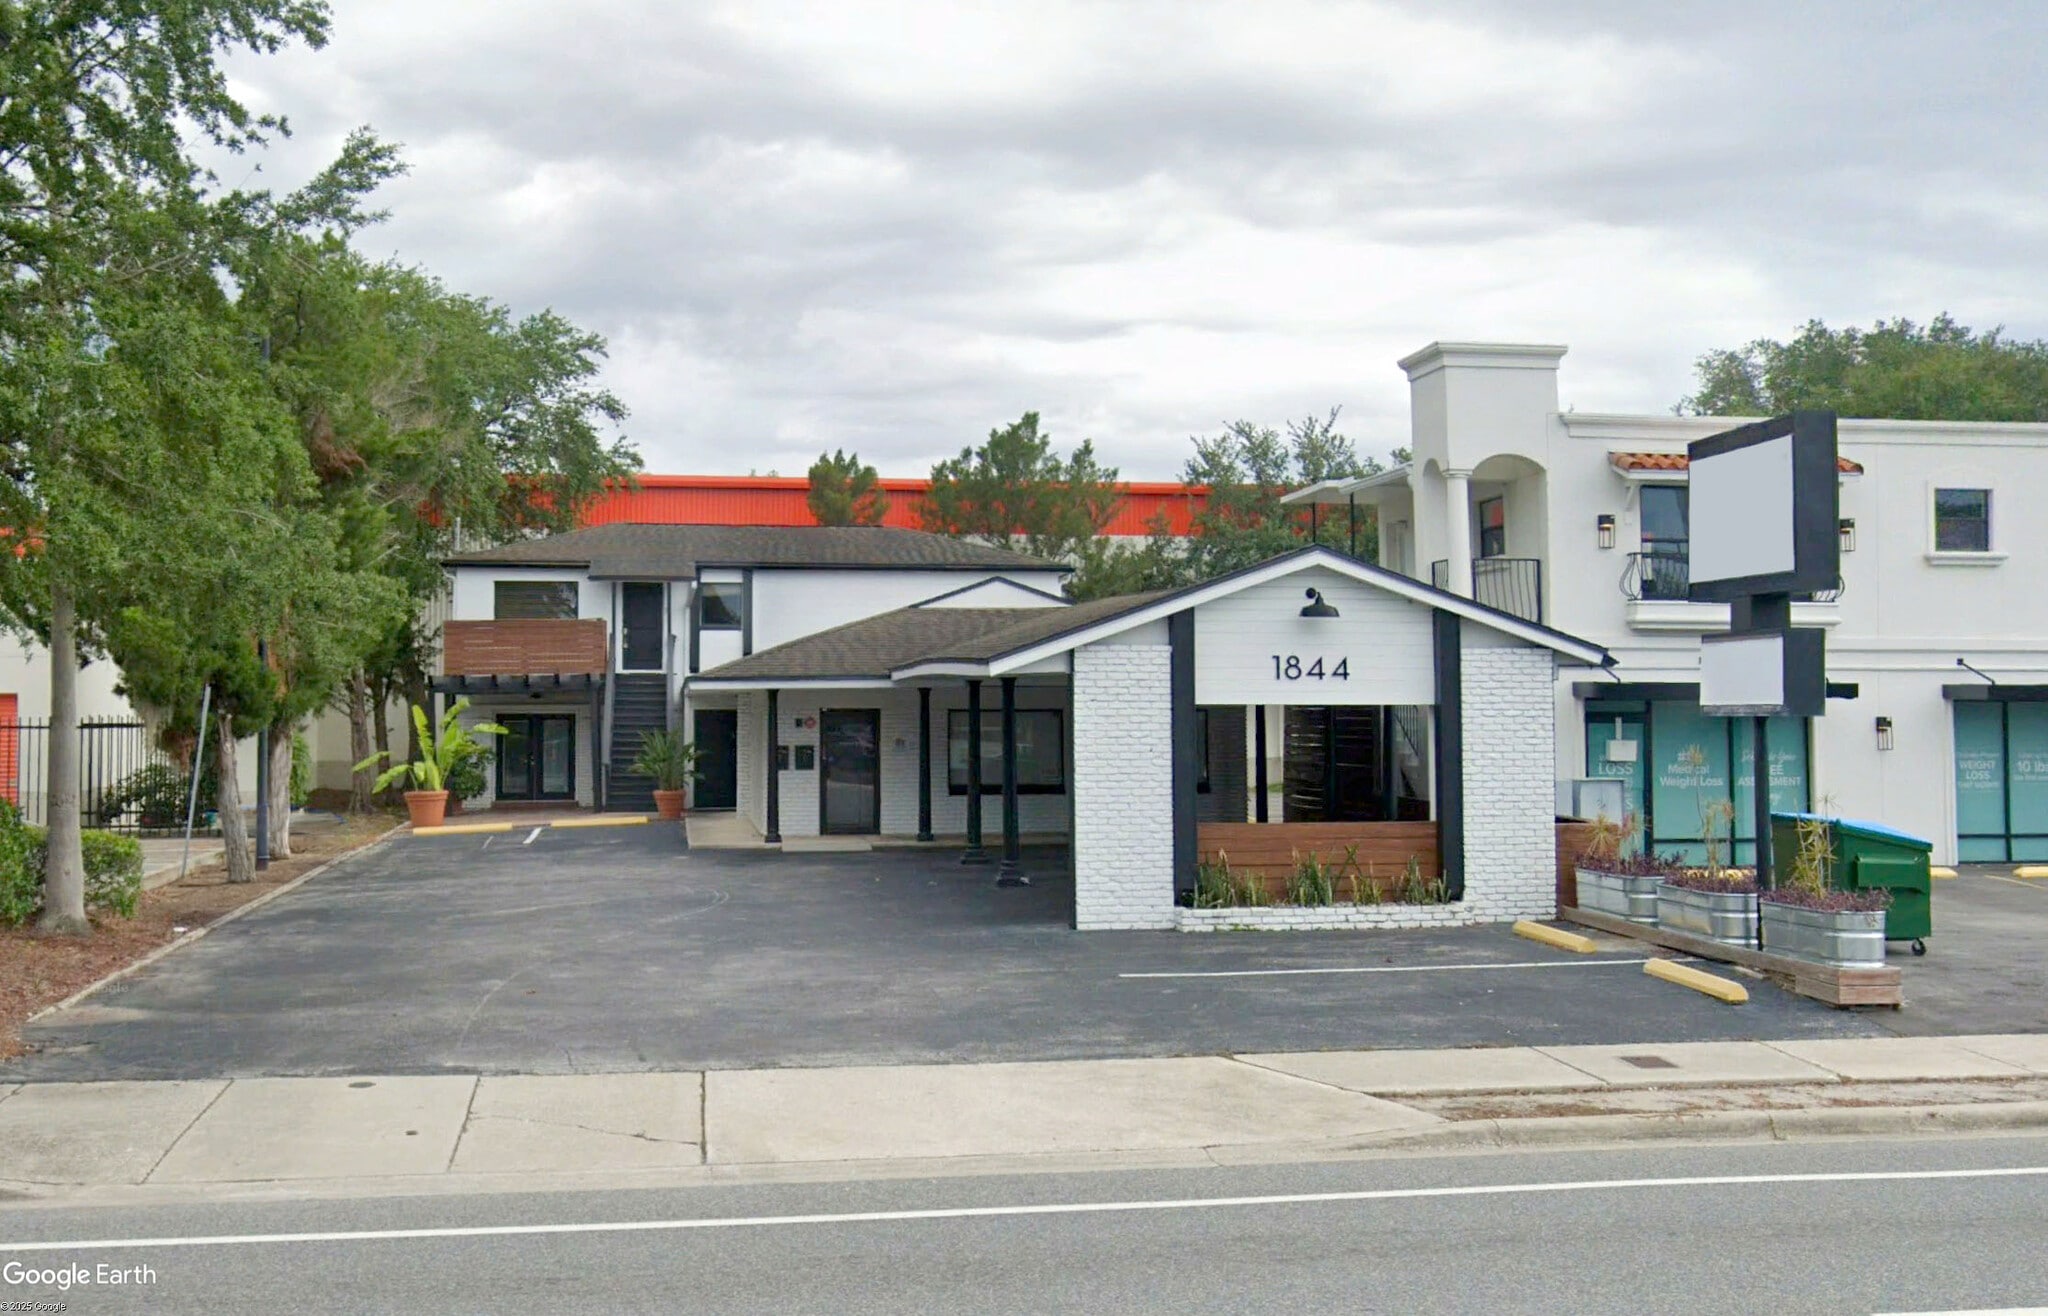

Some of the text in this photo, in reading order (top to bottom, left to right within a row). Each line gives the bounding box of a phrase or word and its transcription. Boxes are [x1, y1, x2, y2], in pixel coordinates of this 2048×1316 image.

[1271, 655, 1350, 680] 1844
[1599, 762, 1633, 775] LOSS
[1960, 761, 1995, 770] WEIGHT
[2017, 760, 2031, 772] 10
[1737, 776, 1801, 786] ASSSMENT
[1966, 770, 1991, 780] LOSS
[1660, 776, 1724, 789] Weight Loss
